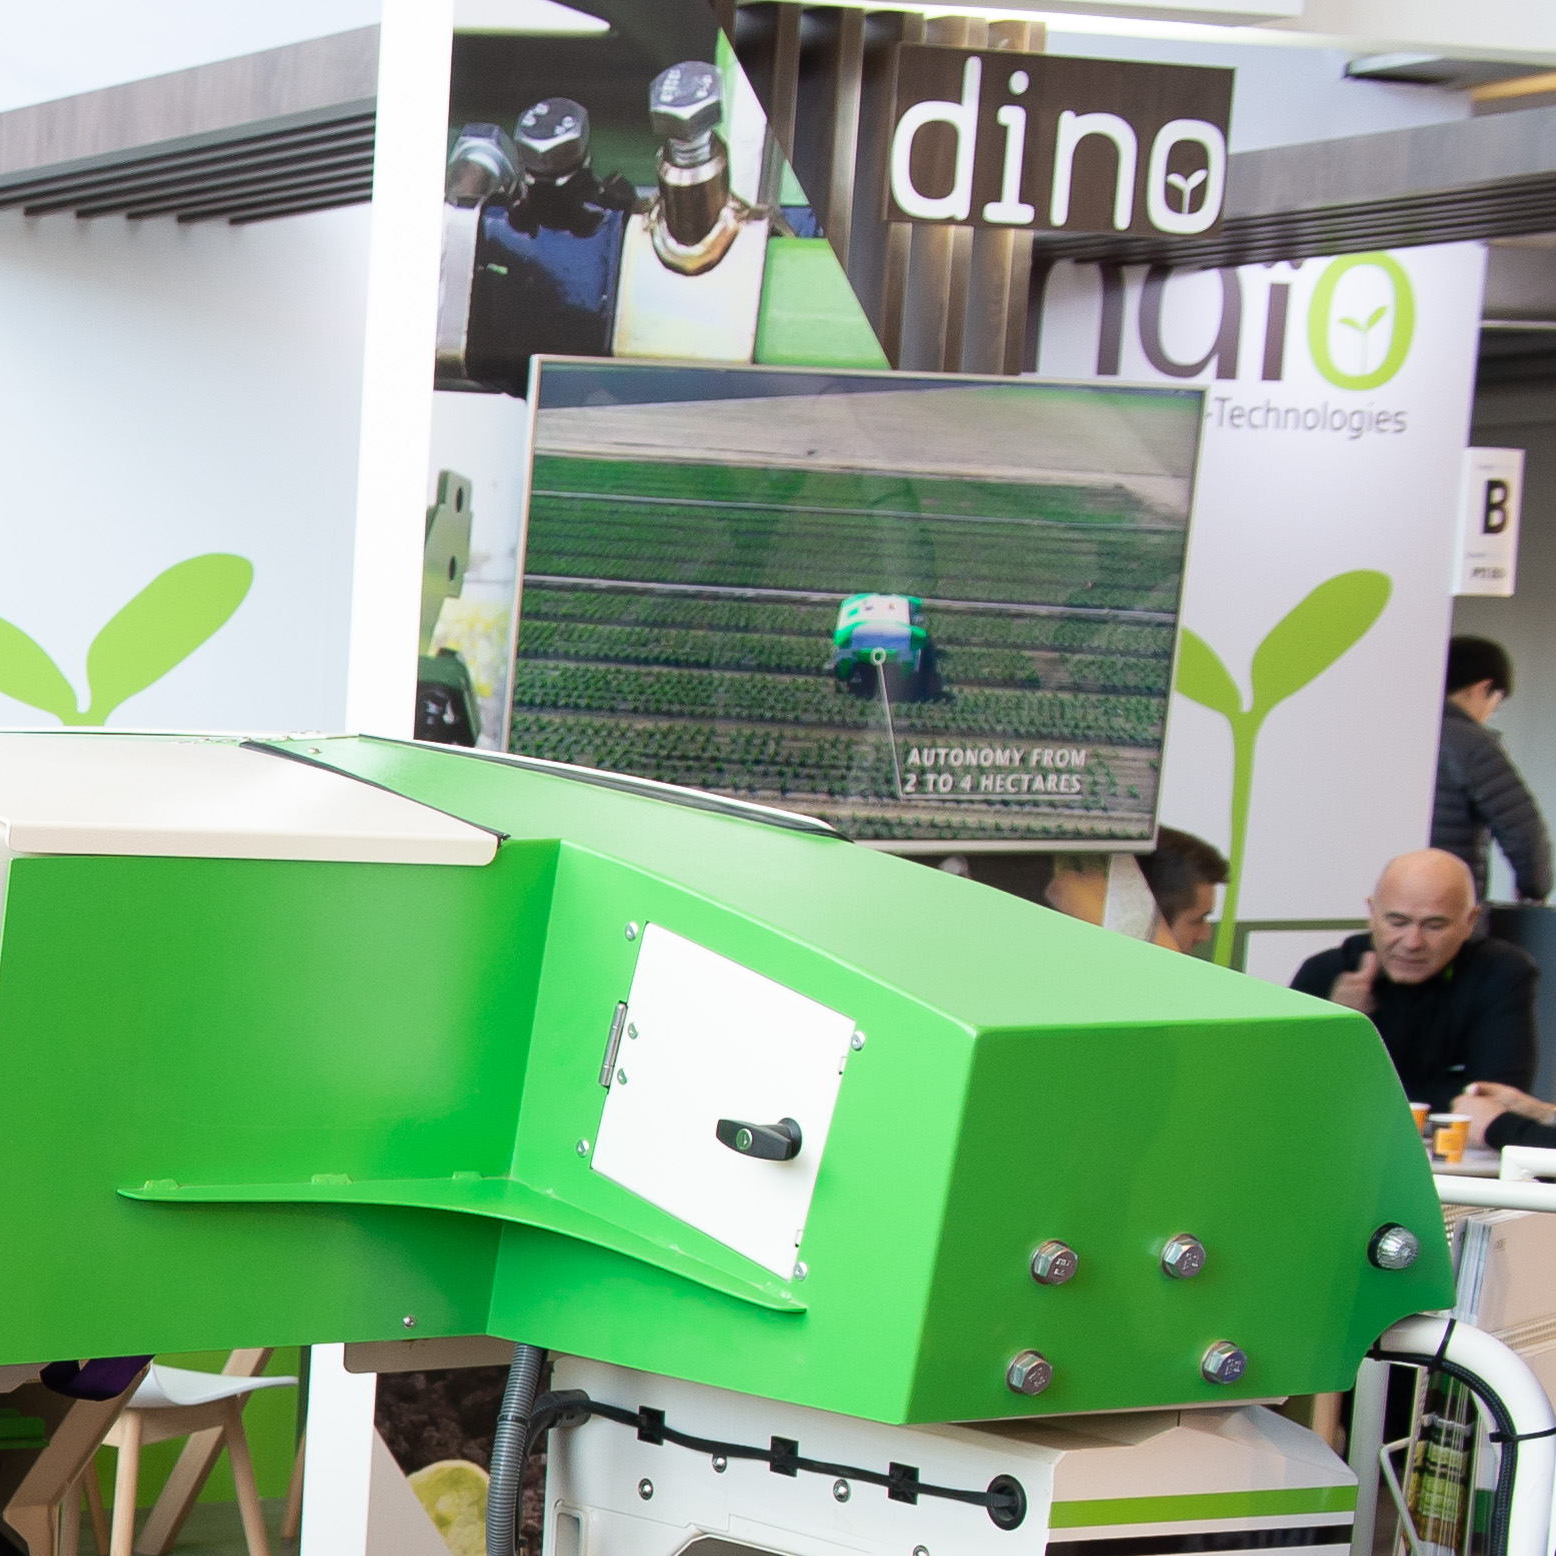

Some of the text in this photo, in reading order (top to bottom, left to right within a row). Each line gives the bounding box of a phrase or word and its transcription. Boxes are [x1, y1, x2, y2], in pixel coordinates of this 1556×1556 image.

[890, 55, 1226, 234] dino
[1214, 397, 1409, 439] Technologies
[1483, 479, 1507, 534] B
[905, 747, 1087, 768] AUTONOMY FROM
[902, 773, 918, 793] 2
[926, 773, 954, 793] TO
[980, 773, 1082, 794] HECTARES
